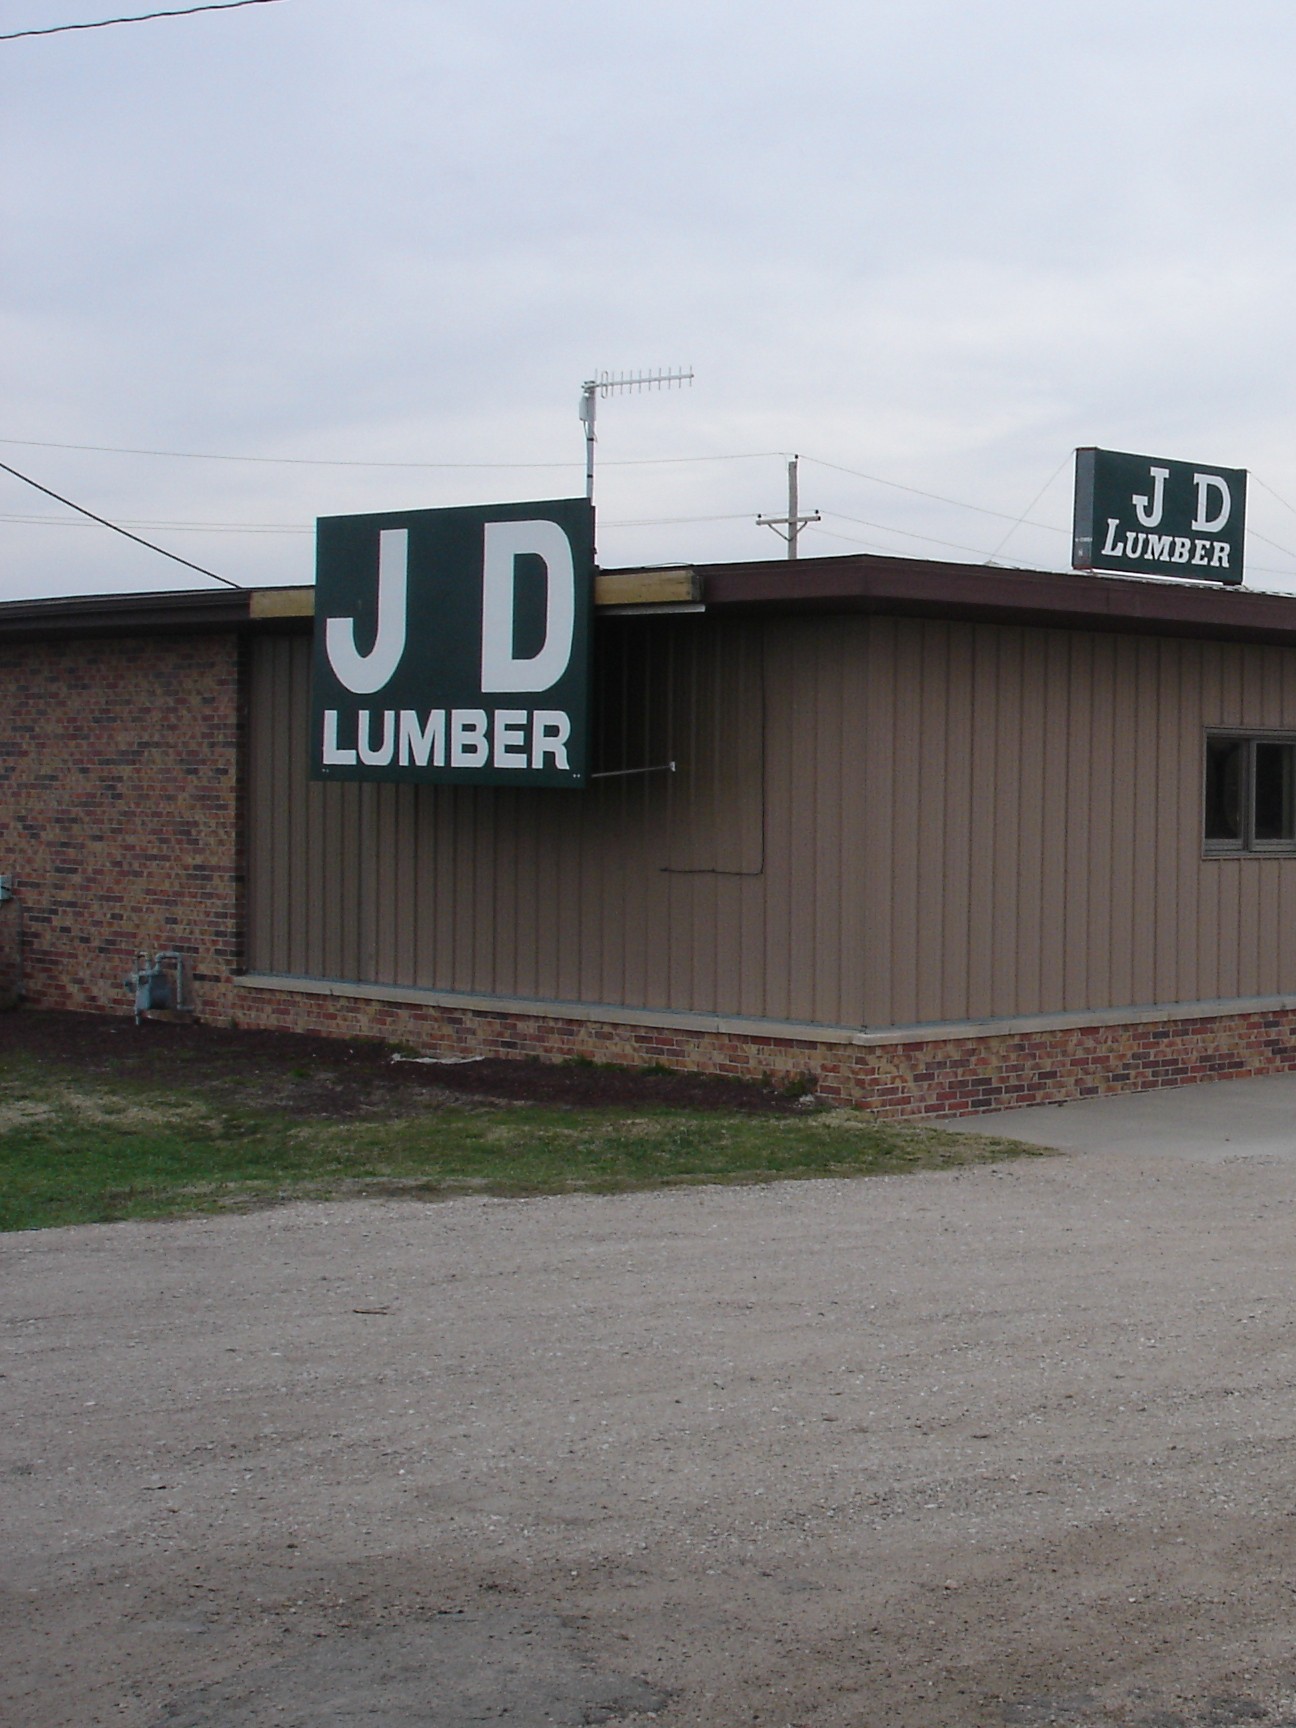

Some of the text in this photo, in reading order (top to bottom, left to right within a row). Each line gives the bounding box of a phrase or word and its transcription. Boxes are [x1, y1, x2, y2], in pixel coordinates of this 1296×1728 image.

[1132, 466, 1232, 533] J D
[1101, 518, 1231, 568] LUMBER
[325, 519, 575, 694] J D
[322, 709, 571, 770] LUMBER
